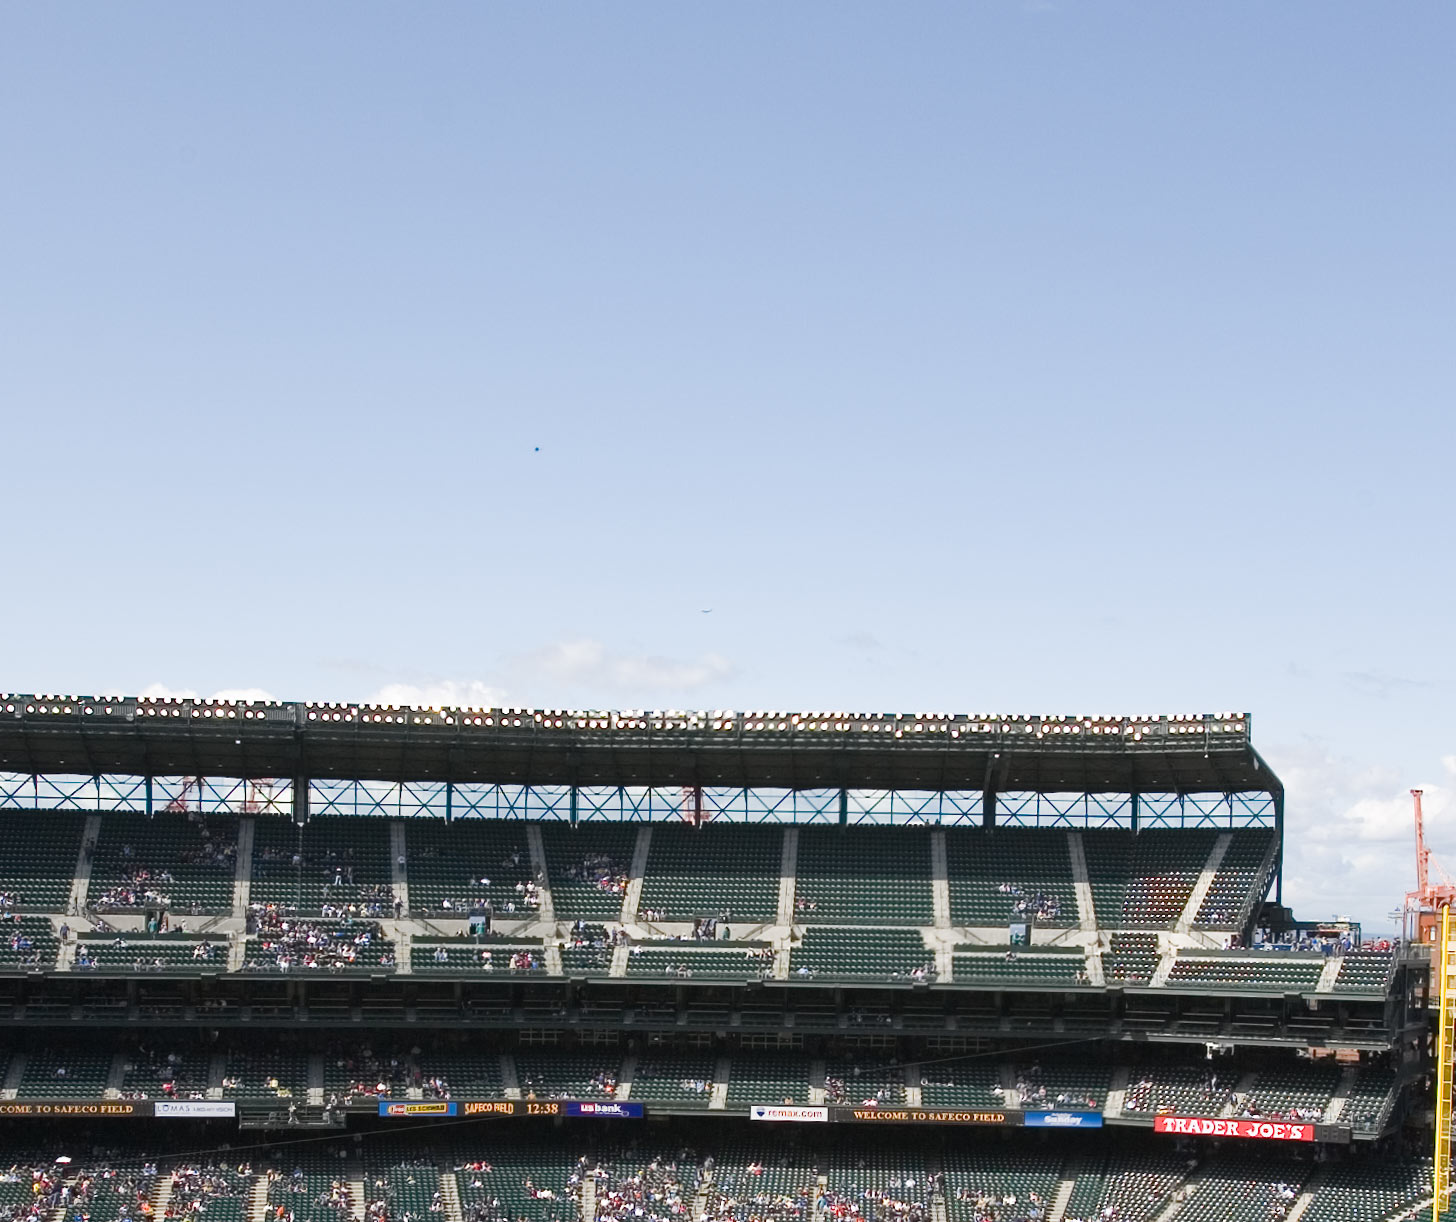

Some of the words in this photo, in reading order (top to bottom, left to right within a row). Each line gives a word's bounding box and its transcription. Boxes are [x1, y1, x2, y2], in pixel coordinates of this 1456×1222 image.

[36, 1105, 51, 1113] TO
[54, 1105, 97, 1114] SAFECO
[100, 1105, 134, 1114] FIELD
[464, 1103, 492, 1115] SAFECO
[494, 1103, 514, 1115] FIELD
[527, 1103, 559, 1115] 12:38
[853, 1111, 908, 1120] WELCOME
[912, 1112, 926, 1121] TO
[929, 1112, 971, 1121] SAFECO
[973, 1113, 1005, 1122] FIELD
[1163, 1117, 1240, 1136] TRADER
[1247, 1121, 1305, 1140] JOE'S
